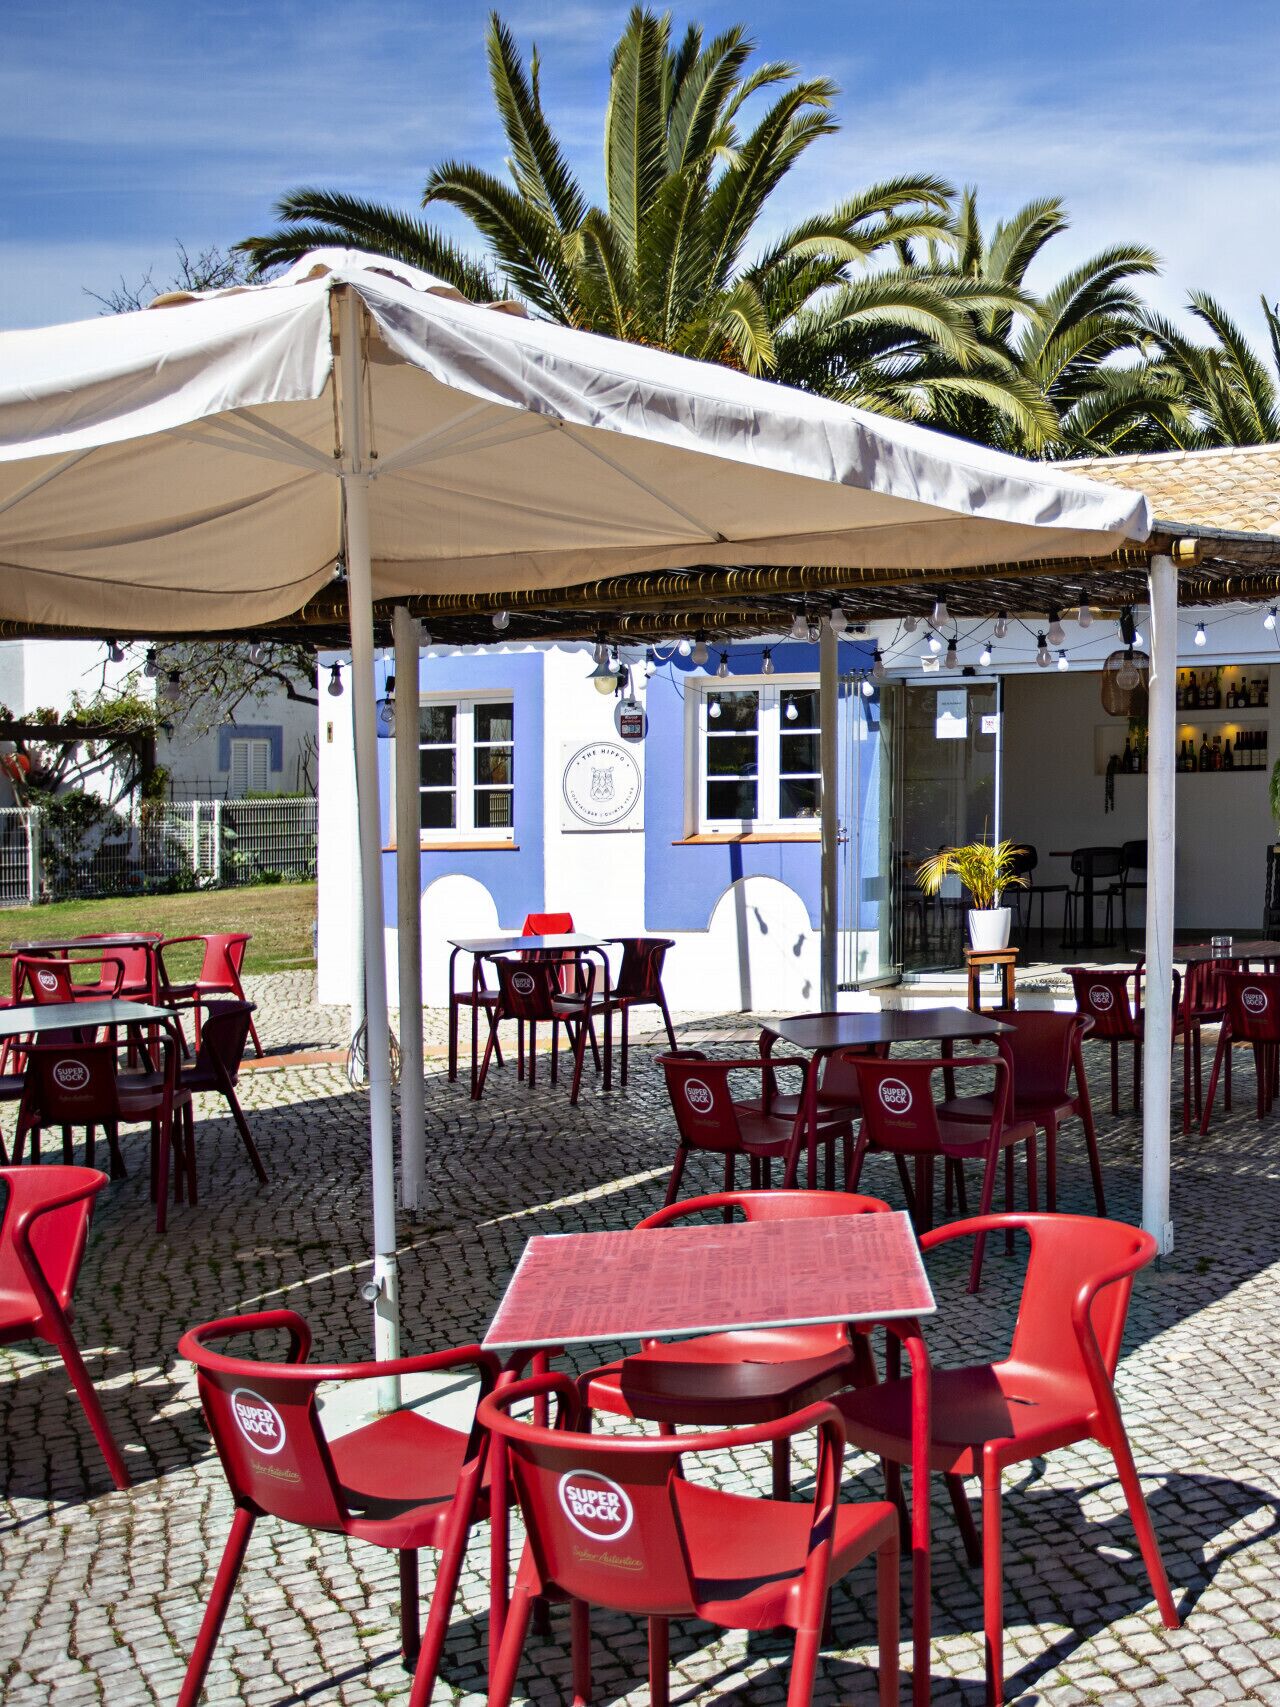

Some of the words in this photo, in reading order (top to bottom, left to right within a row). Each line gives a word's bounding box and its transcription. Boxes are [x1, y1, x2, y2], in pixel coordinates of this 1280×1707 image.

[582, 750, 596, 760] THE
[601, 749, 624, 761] HIPPO
[57, 1067, 84, 1075] SUPER
[688, 1088, 708, 1096] SUPER
[882, 1087, 907, 1096] SUPER
[690, 1094, 710, 1103] BOCK
[884, 1094, 907, 1103] BOCK
[236, 1403, 275, 1423] SUPER
[243, 1416, 278, 1437] BOCK
[566, 1486, 621, 1508] SUPER
[571, 1500, 622, 1522] BOCK
